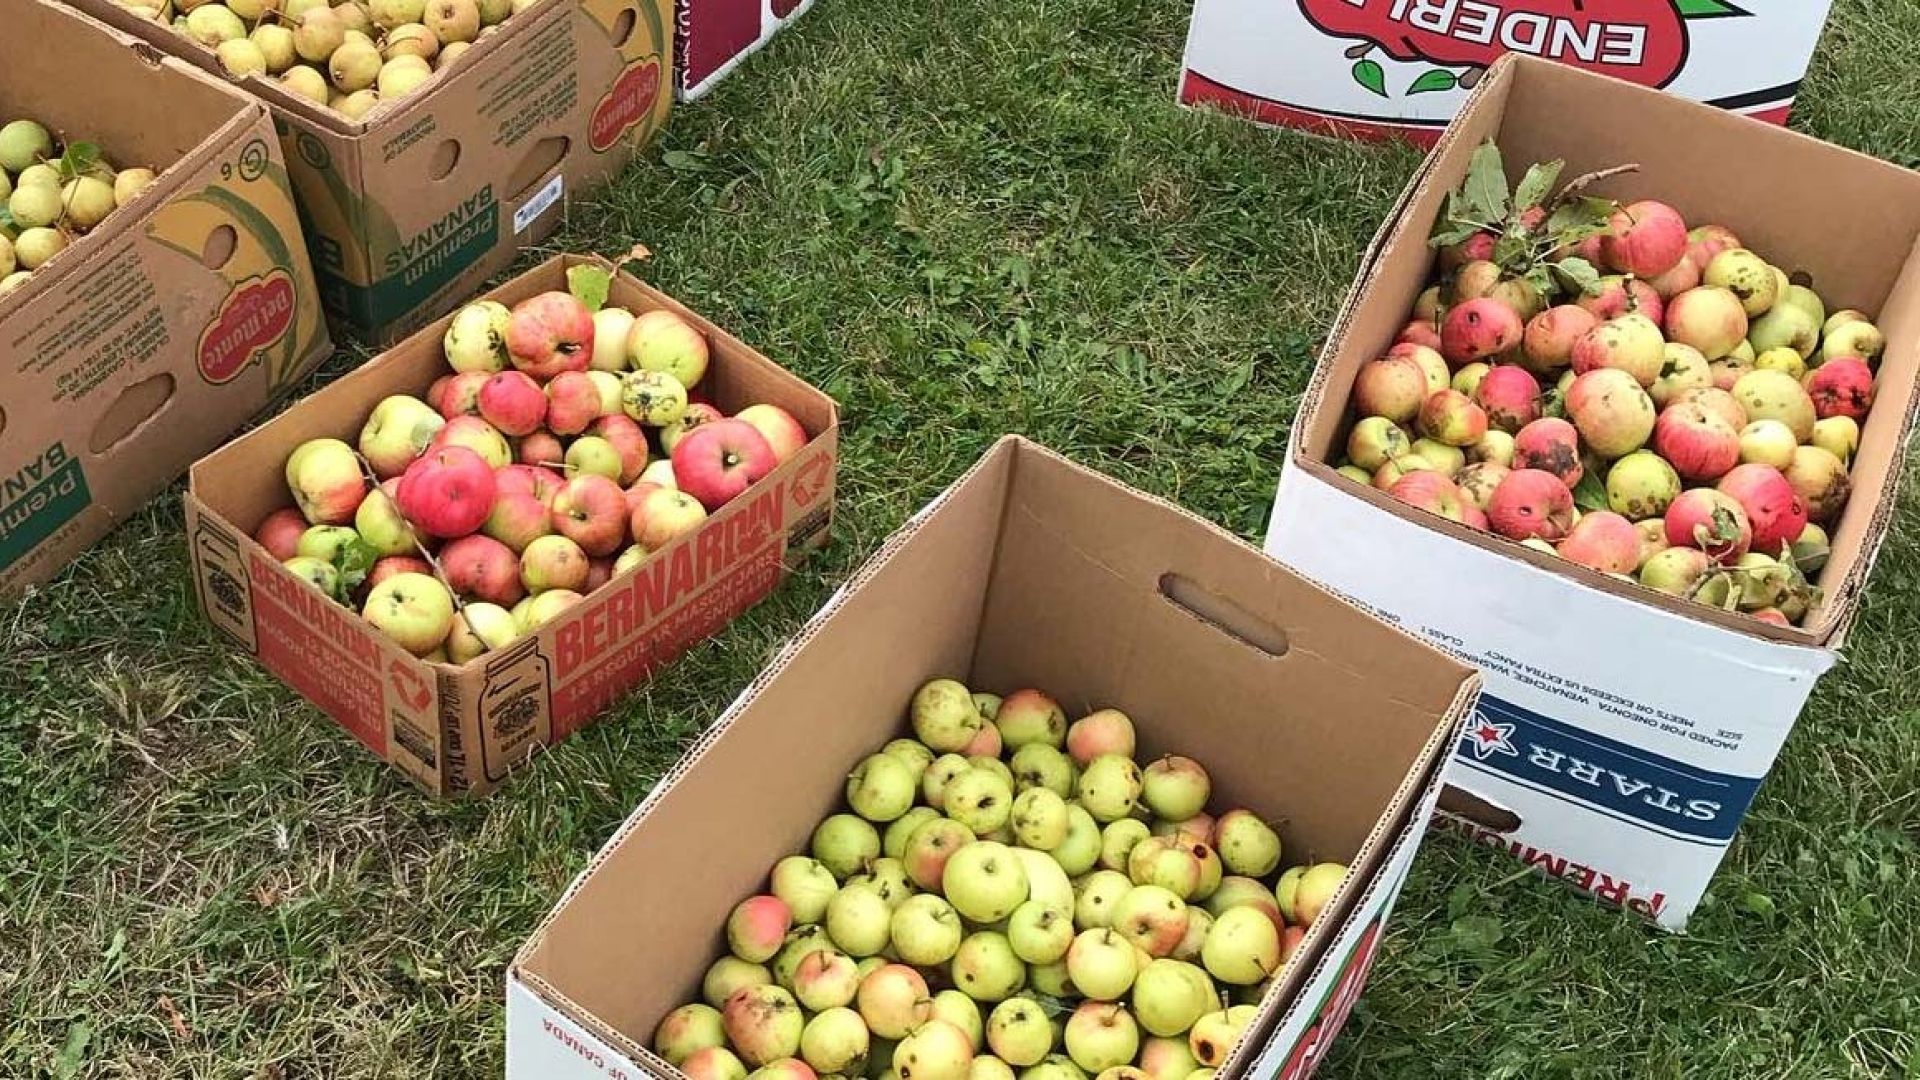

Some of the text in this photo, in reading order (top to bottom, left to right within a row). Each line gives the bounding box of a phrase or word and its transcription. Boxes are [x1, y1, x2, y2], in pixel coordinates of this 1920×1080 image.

[1333, 0, 1647, 65] ENDER
[385, 183, 493, 274] BANANAS
[403, 209, 494, 286] Premium
[263, 289, 290, 326] Del
[204, 312, 262, 370] Monte
[0, 440, 67, 507] BAN
[555, 482, 784, 681] BERNARDIN
[251, 552, 385, 678] BERNARDIN
[1483, 649, 1523, 670] FANCY
[1524, 664, 1563, 685] EXTRA
[1564, 678, 1580, 691] US
[1582, 684, 1635, 708] EXCEEDS
[1598, 701, 1659, 727] ONEONTA
[1636, 702, 1655, 715] OR
[1656, 708, 1695, 728] MEETS
[1659, 722, 1688, 739] FOR
[1689, 731, 1739, 751] PACKED
[1529, 743, 1723, 822] STARR
[542, 1018, 605, 1068] CANADA
